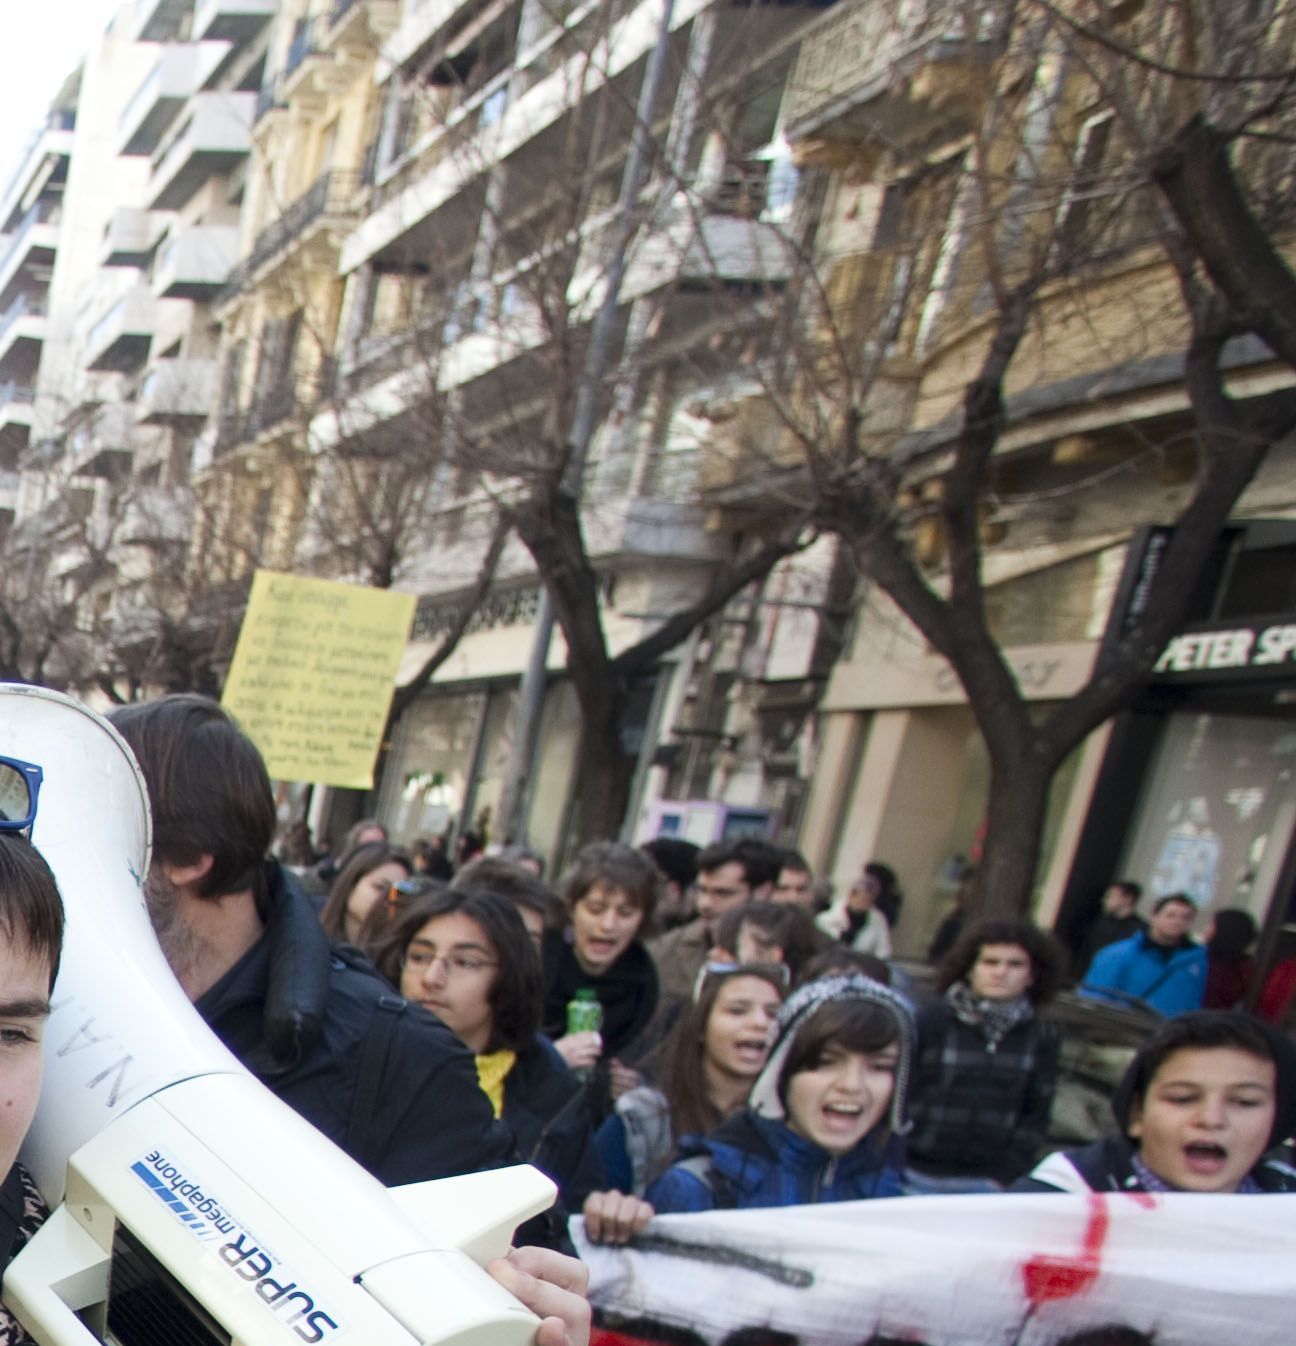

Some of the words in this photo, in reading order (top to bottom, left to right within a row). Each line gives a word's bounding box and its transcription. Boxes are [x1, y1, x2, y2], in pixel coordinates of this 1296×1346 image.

[1253, 624, 1296, 666] SP
[144, 1149, 236, 1236] megaphone
[218, 1233, 339, 1346] SUPER
